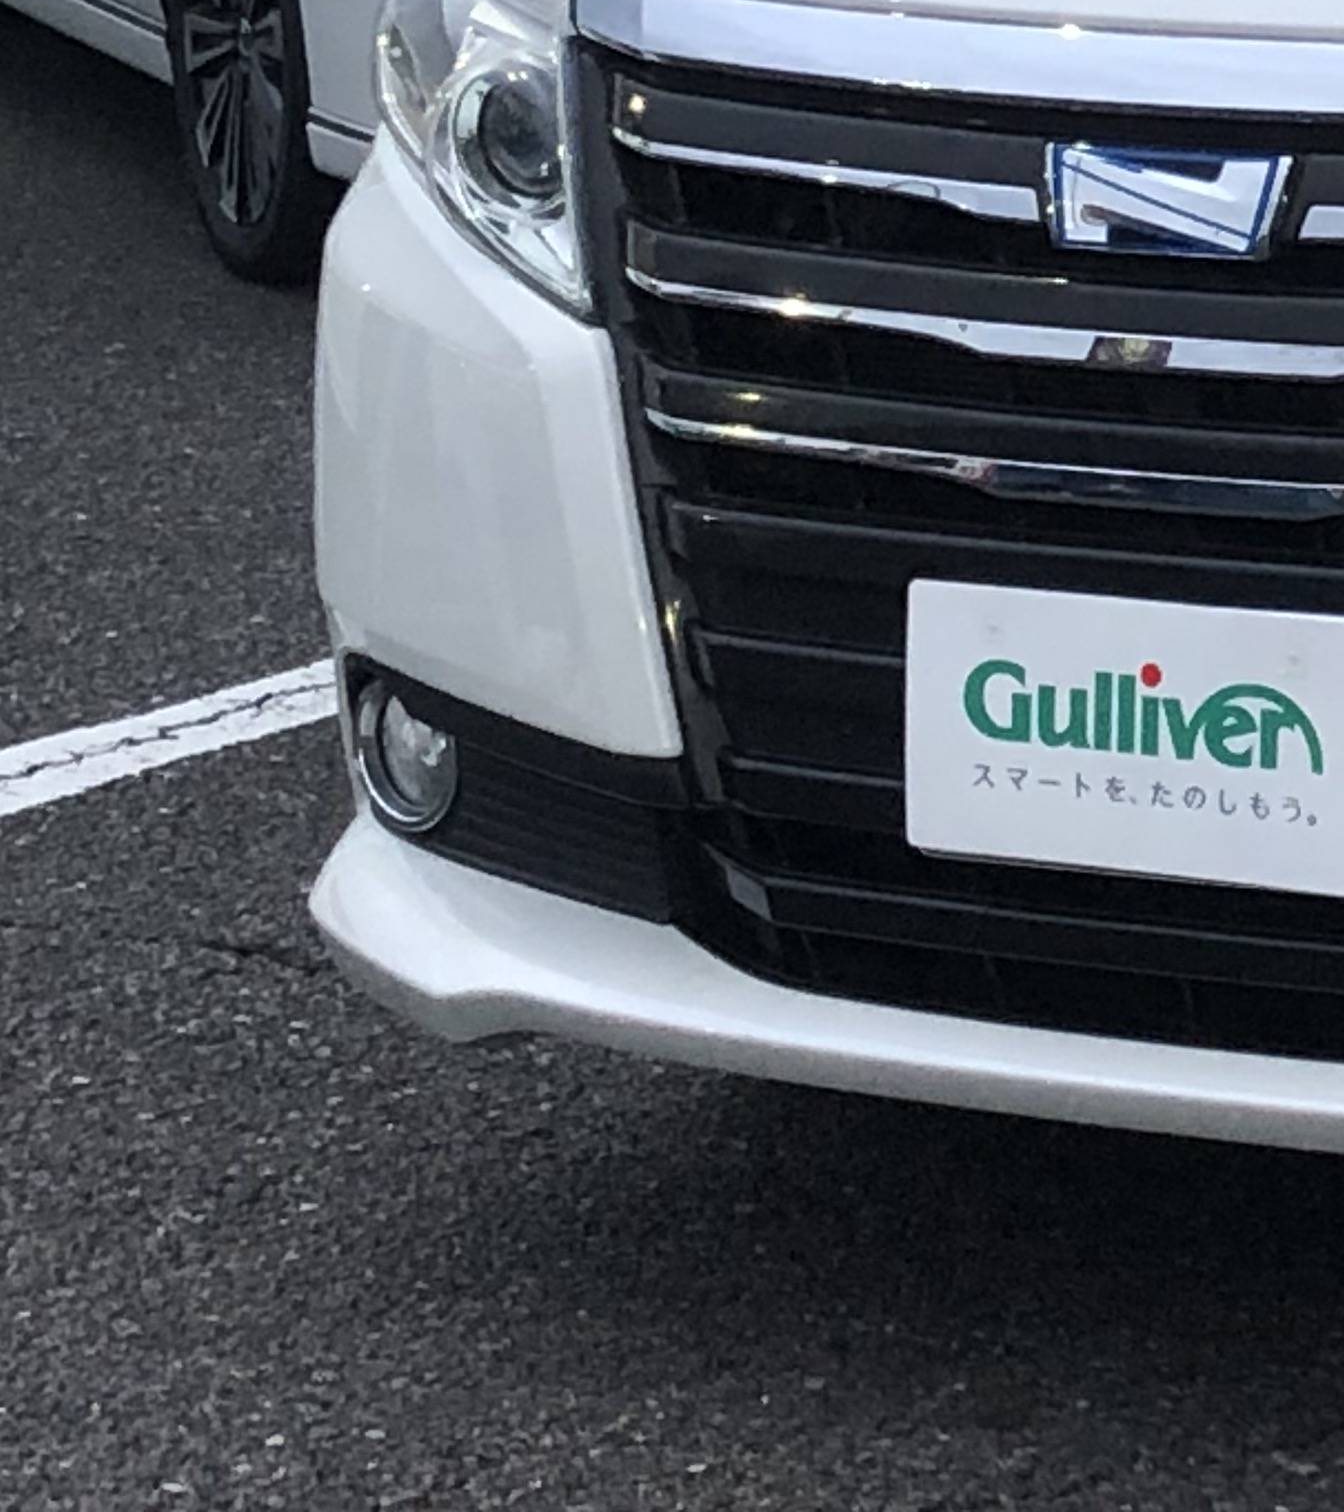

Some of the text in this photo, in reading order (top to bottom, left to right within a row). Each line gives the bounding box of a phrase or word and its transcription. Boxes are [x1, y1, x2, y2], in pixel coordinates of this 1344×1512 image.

[963, 658, 1324, 776] Gulliver
[972, 763, 1319, 827] スマートを、たのしもう。
